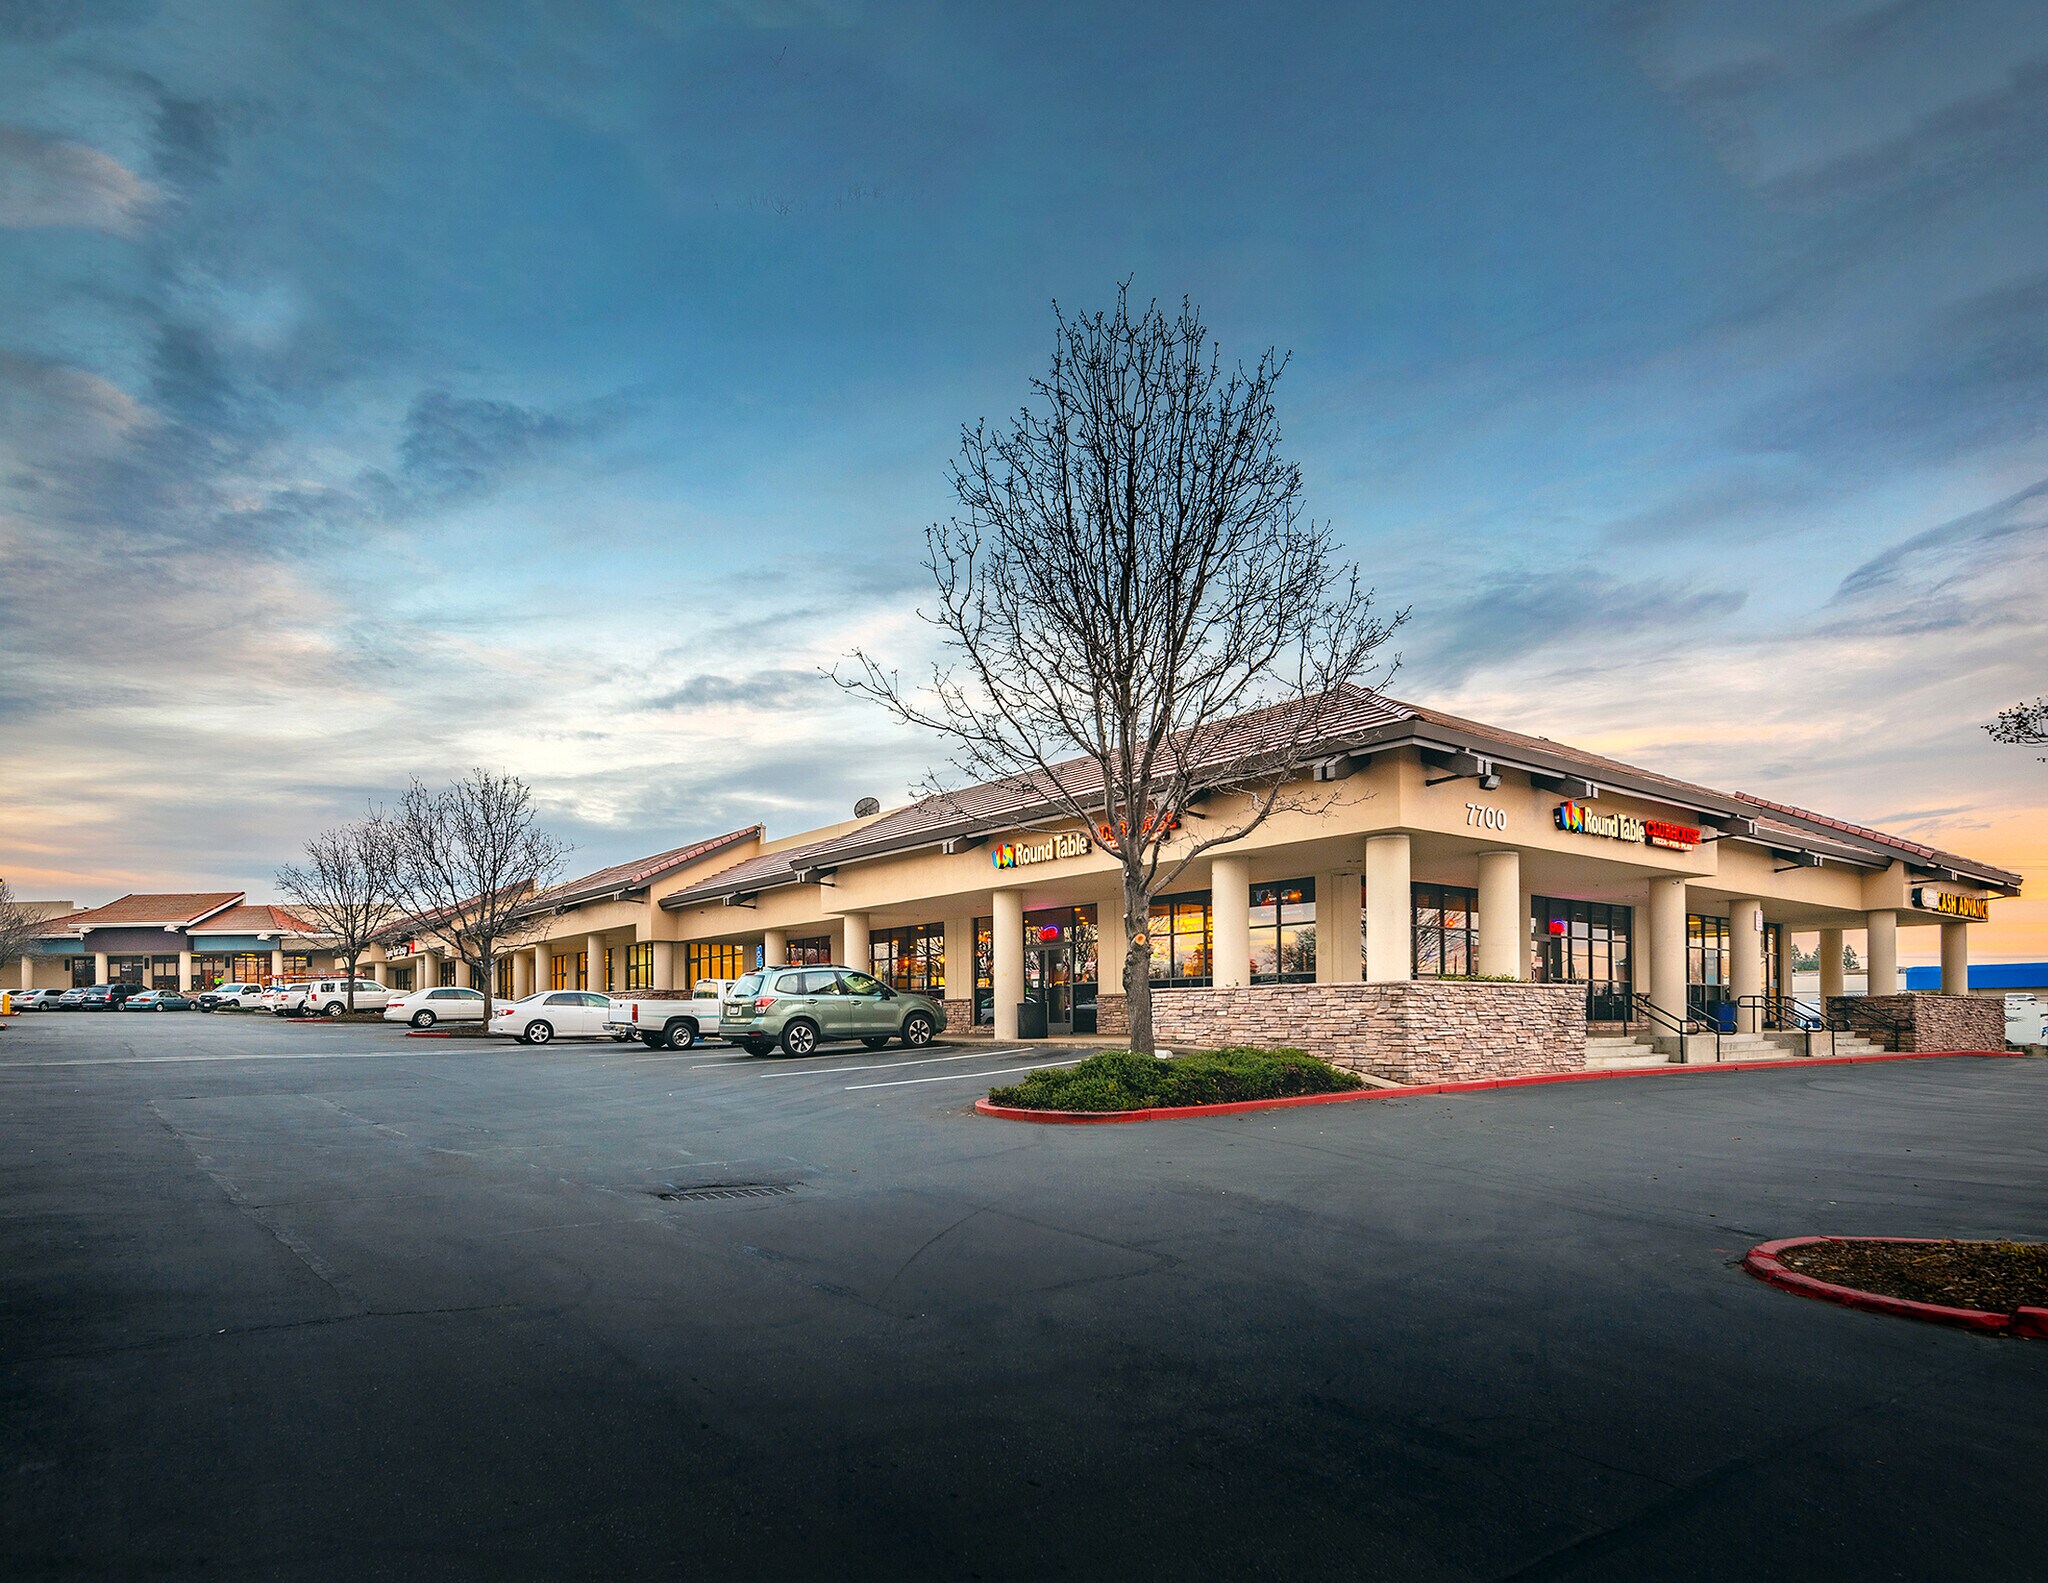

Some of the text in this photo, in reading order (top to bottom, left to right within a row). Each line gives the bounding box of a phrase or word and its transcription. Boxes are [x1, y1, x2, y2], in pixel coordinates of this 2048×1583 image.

[1465, 802, 1507, 831] 7700
[1584, 806, 1645, 843] Round Table
[1645, 820, 1701, 845] CLUBHOUSE
[1016, 839, 1053, 865] Round
[1054, 833, 1088, 858] Table
[1937, 892, 1957, 914] CASH
